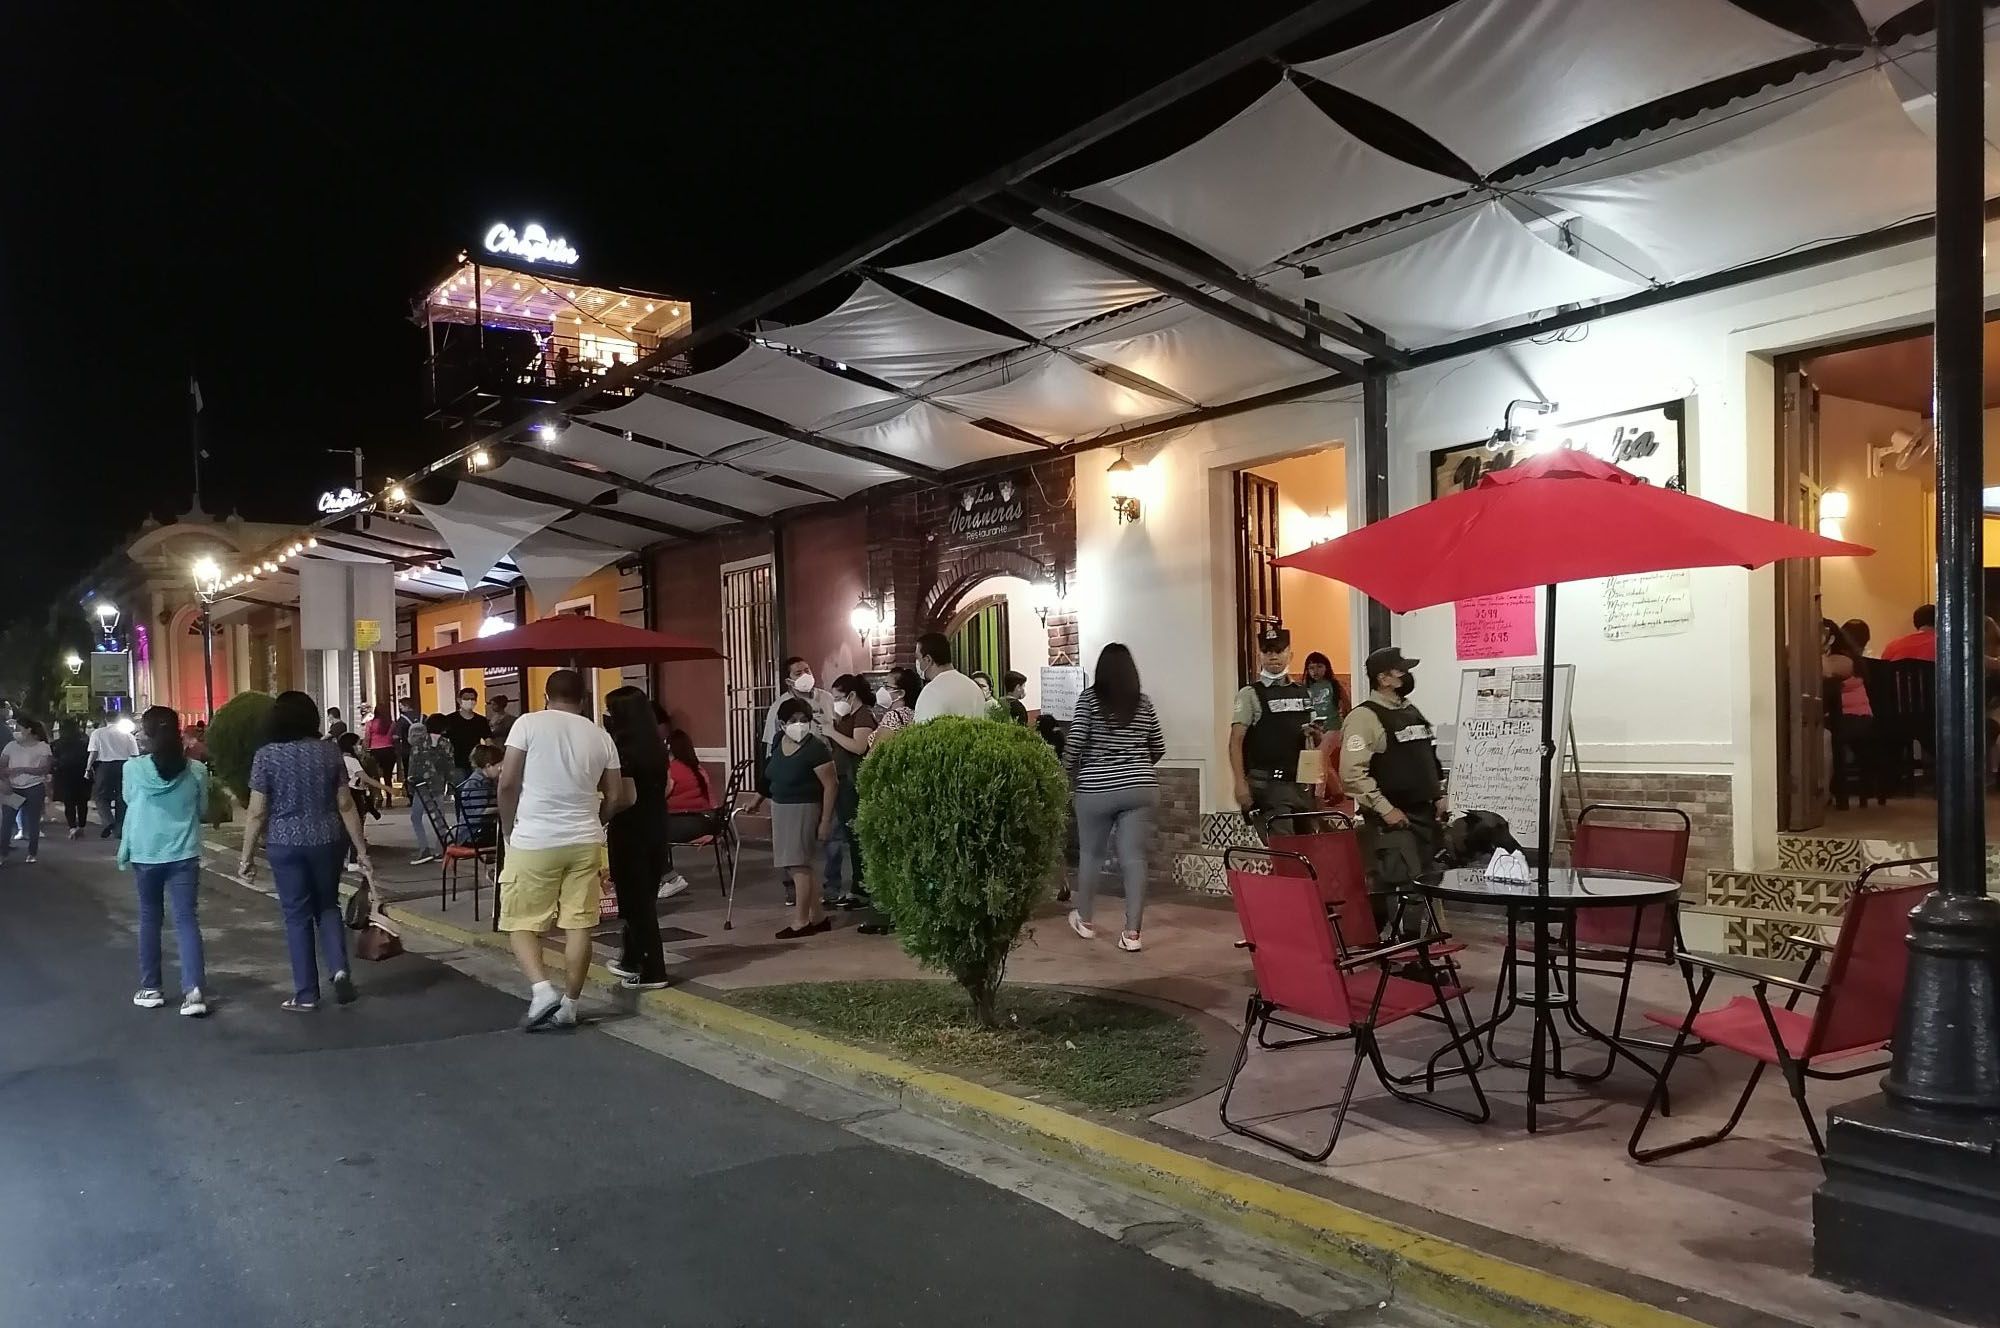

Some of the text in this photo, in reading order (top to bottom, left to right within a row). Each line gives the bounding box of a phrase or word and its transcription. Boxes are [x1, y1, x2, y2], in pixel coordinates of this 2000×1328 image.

[319, 491, 367, 511] Chapli
[974, 487, 994, 505] Las
[949, 501, 1023, 535] Veraneras
[966, 525, 1008, 541] Restaurante
